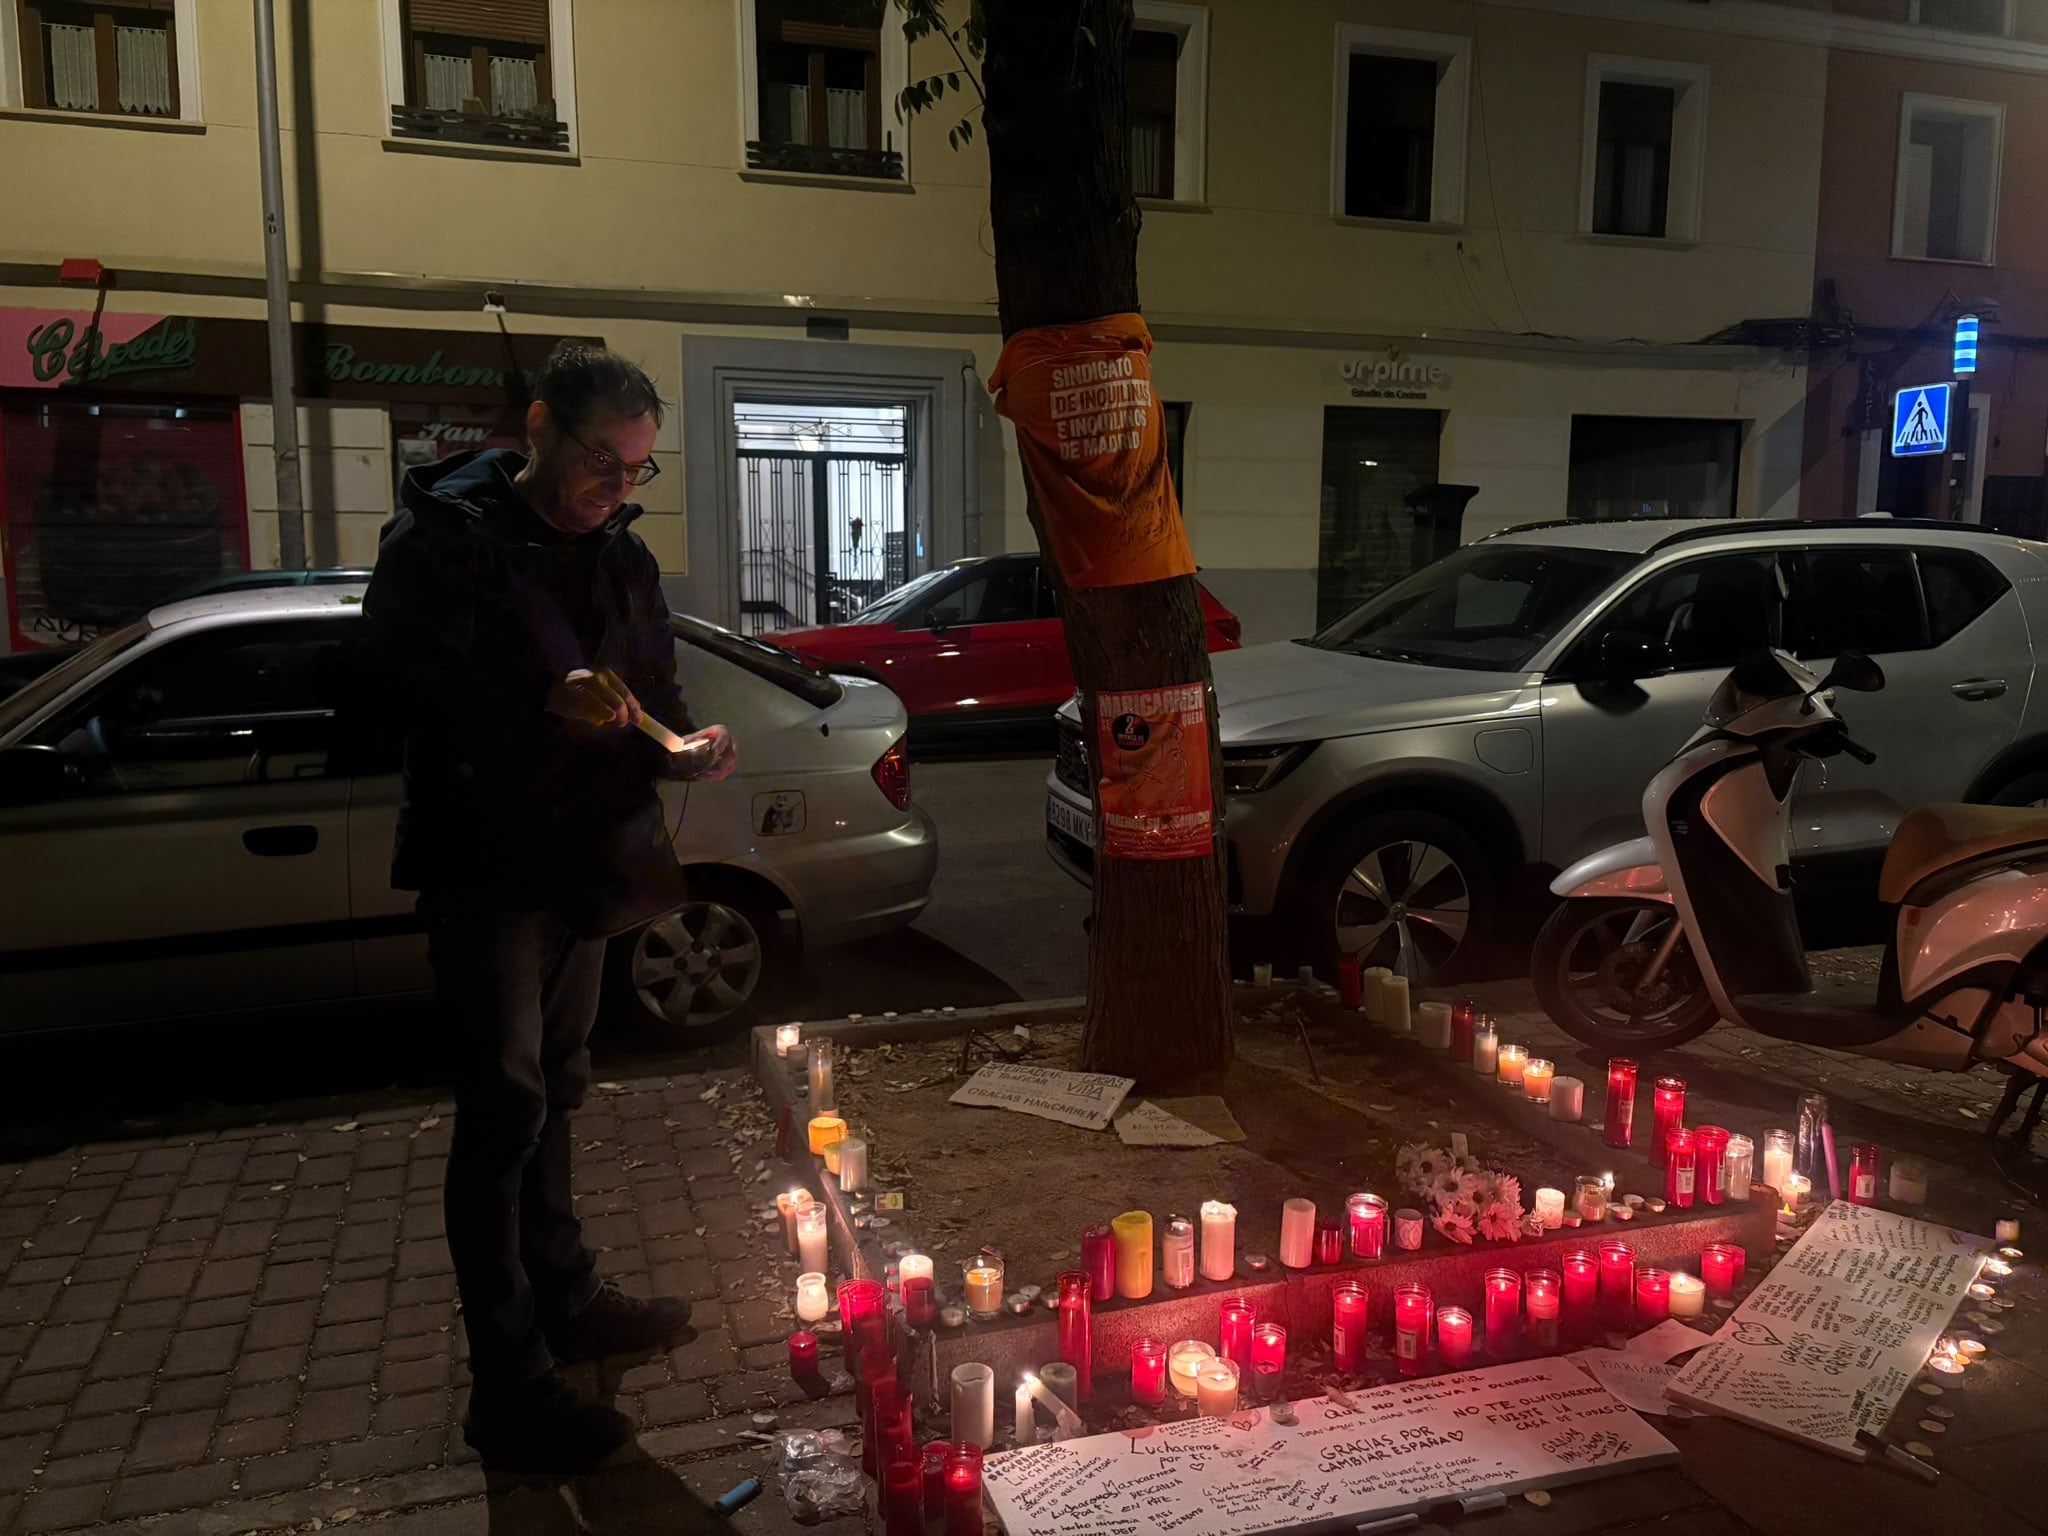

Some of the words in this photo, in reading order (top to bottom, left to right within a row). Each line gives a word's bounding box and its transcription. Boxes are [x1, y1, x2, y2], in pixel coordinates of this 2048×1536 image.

[1052, 356, 1134, 389] SINDICATO
[1340, 360, 1444, 384] urpime
[1055, 394, 1078, 414] DE
[1079, 382, 1151, 410] INQUILINAS
[1056, 421, 1068, 440] E
[1069, 408, 1147, 437] INQUILINOS
[1059, 440, 1080, 460] DE
[1083, 431, 1141, 456] MADRID
[1098, 685, 1204, 718] MARICARMEN
[967, 1087, 1021, 1103] GRACIAS
[1066, 1082, 1105, 1098] VIDA
[1371, 1402, 1394, 1411] NO
[1402, 1388, 1466, 1405] VUELVA
[1452, 1406, 1481, 1419] NO
[1484, 1400, 1516, 1411] TE
[1519, 1385, 1607, 1406] OLVIDAREMOS
[1486, 1407, 1545, 1426] FUISTE
[1551, 1403, 1573, 1414] LA
[1515, 1418, 1552, 1431] CASA
[1130, 1437, 1221, 1455] Lucharemos
[1317, 1450, 1392, 1473] CAMBIAR
[1391, 1436, 1452, 1455] ESPAÑA
[1320, 1433, 1394, 1460] GRACIAS
[1399, 1425, 1435, 1441] POR
[1159, 1456, 1181, 1470] por
